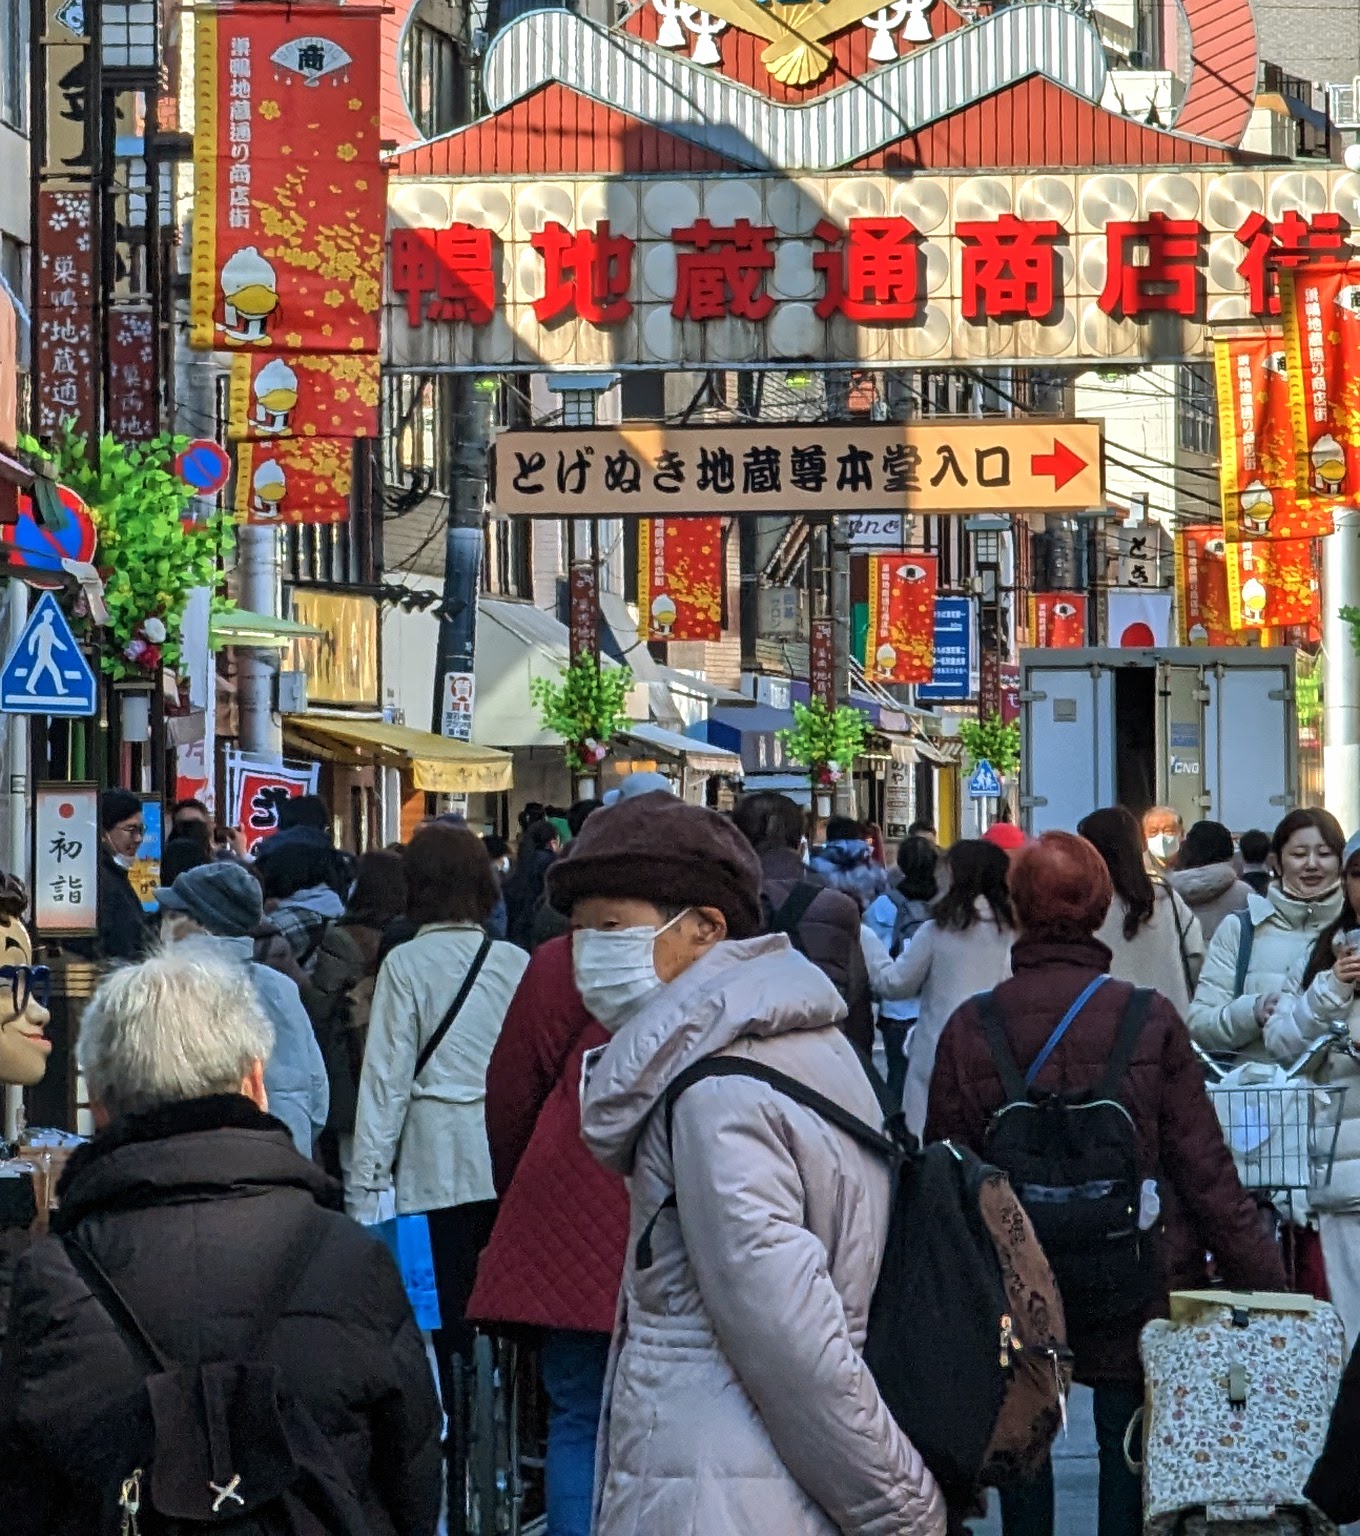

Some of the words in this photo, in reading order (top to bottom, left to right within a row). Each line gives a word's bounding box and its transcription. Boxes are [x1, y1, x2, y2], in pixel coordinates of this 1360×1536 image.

[512, 443, 1012, 497] とげぬき地蔵尊本堂入口
[49, 831, 83, 905] 初詣
